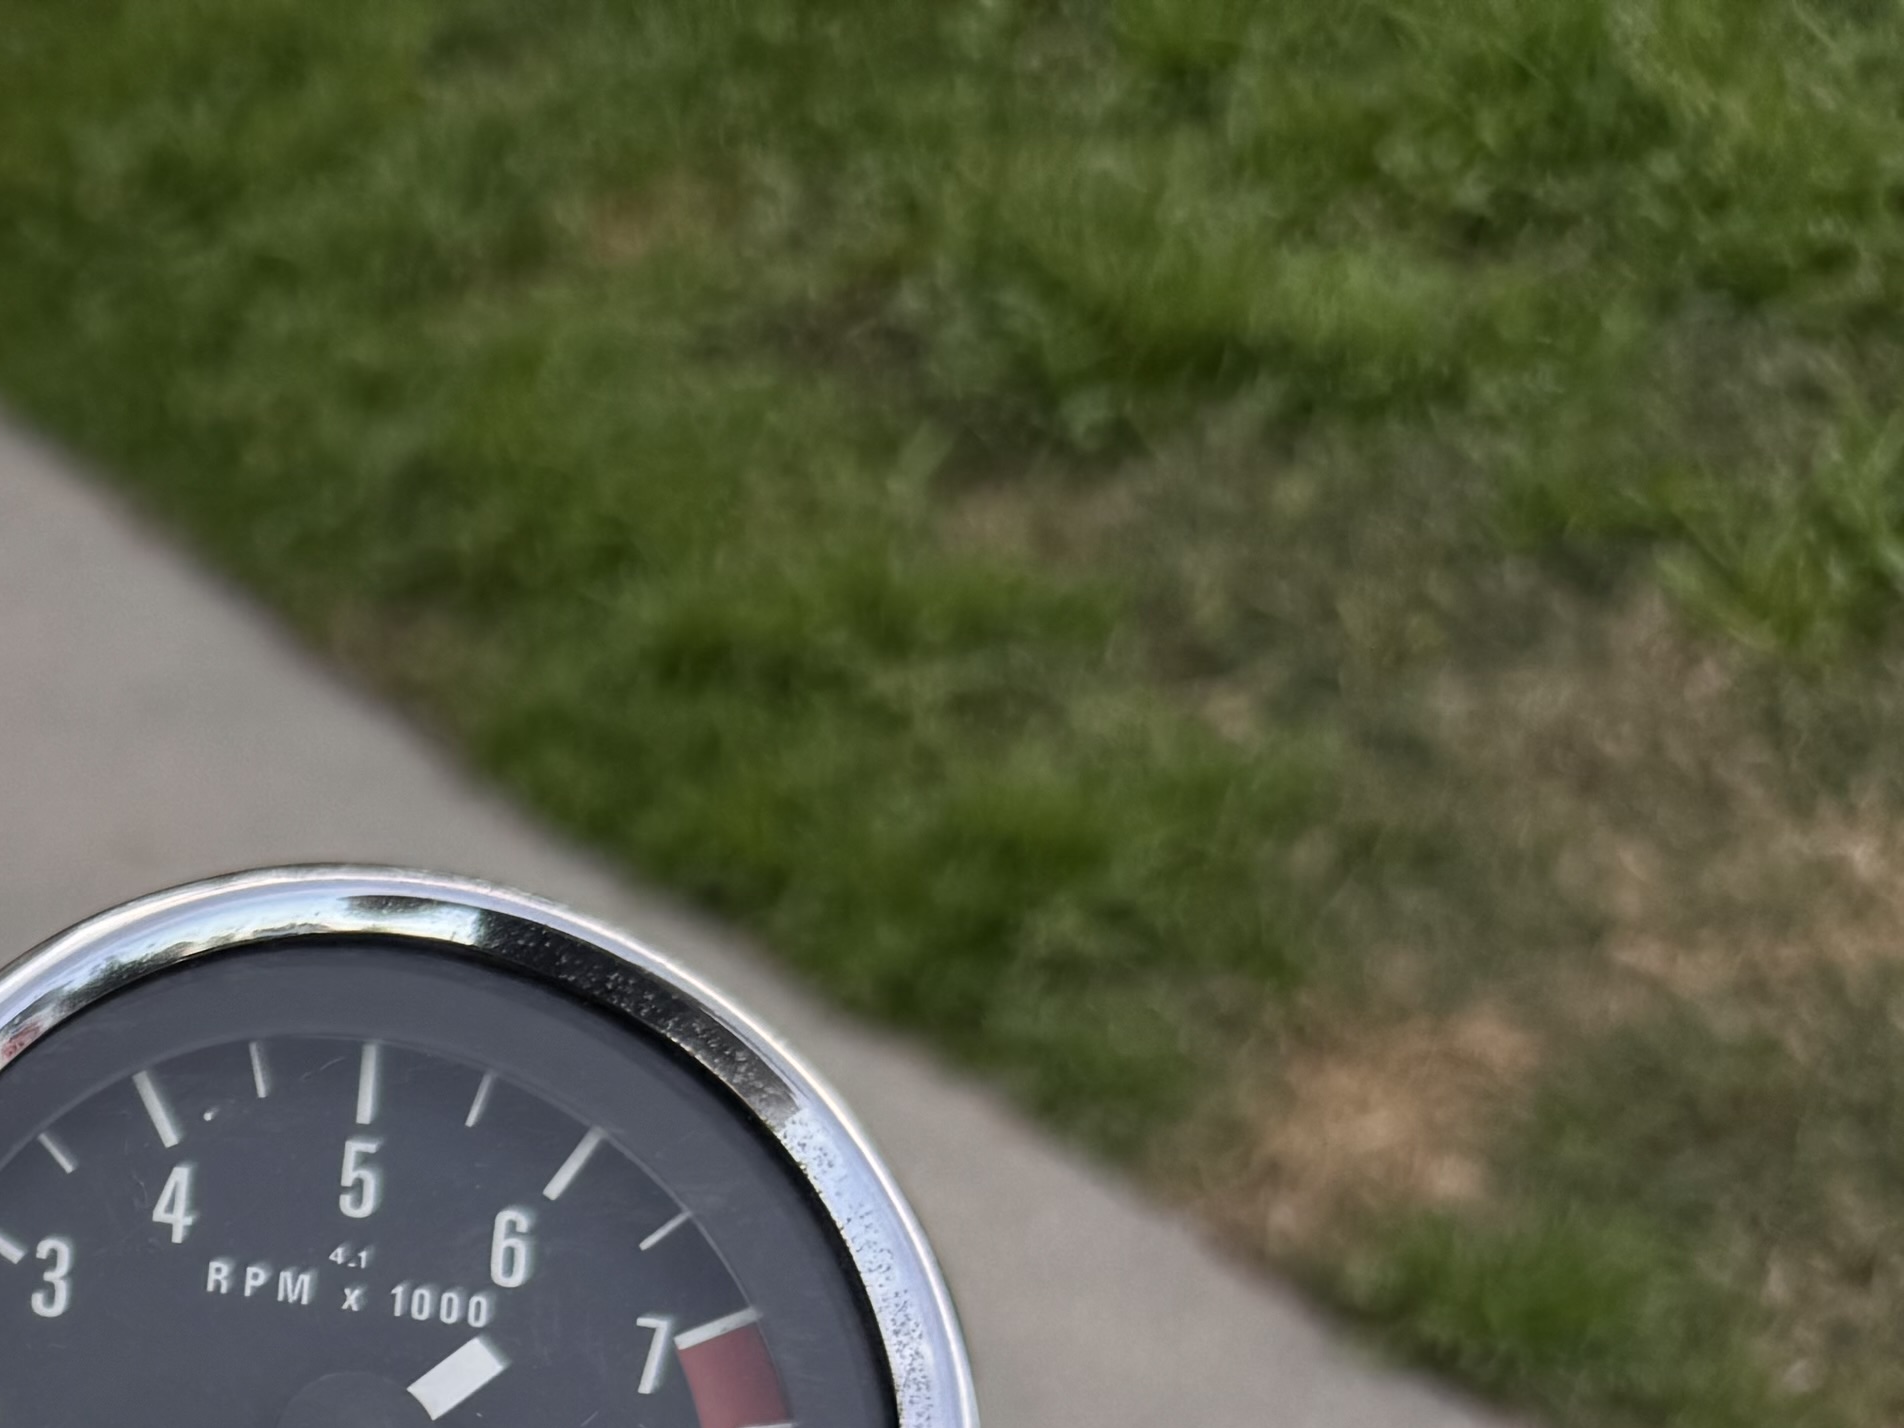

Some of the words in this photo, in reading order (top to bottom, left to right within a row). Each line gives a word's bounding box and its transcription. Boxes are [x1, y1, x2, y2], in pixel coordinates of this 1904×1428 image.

[152, 1166, 196, 1243] 4
[339, 1140, 380, 1218] 5
[31, 1238, 71, 1317] 3
[491, 1209, 530, 1288] 6
[206, 1261, 311, 1305] RPM
[391, 1285, 489, 1328] 1000
[636, 1317, 669, 1394] 7
